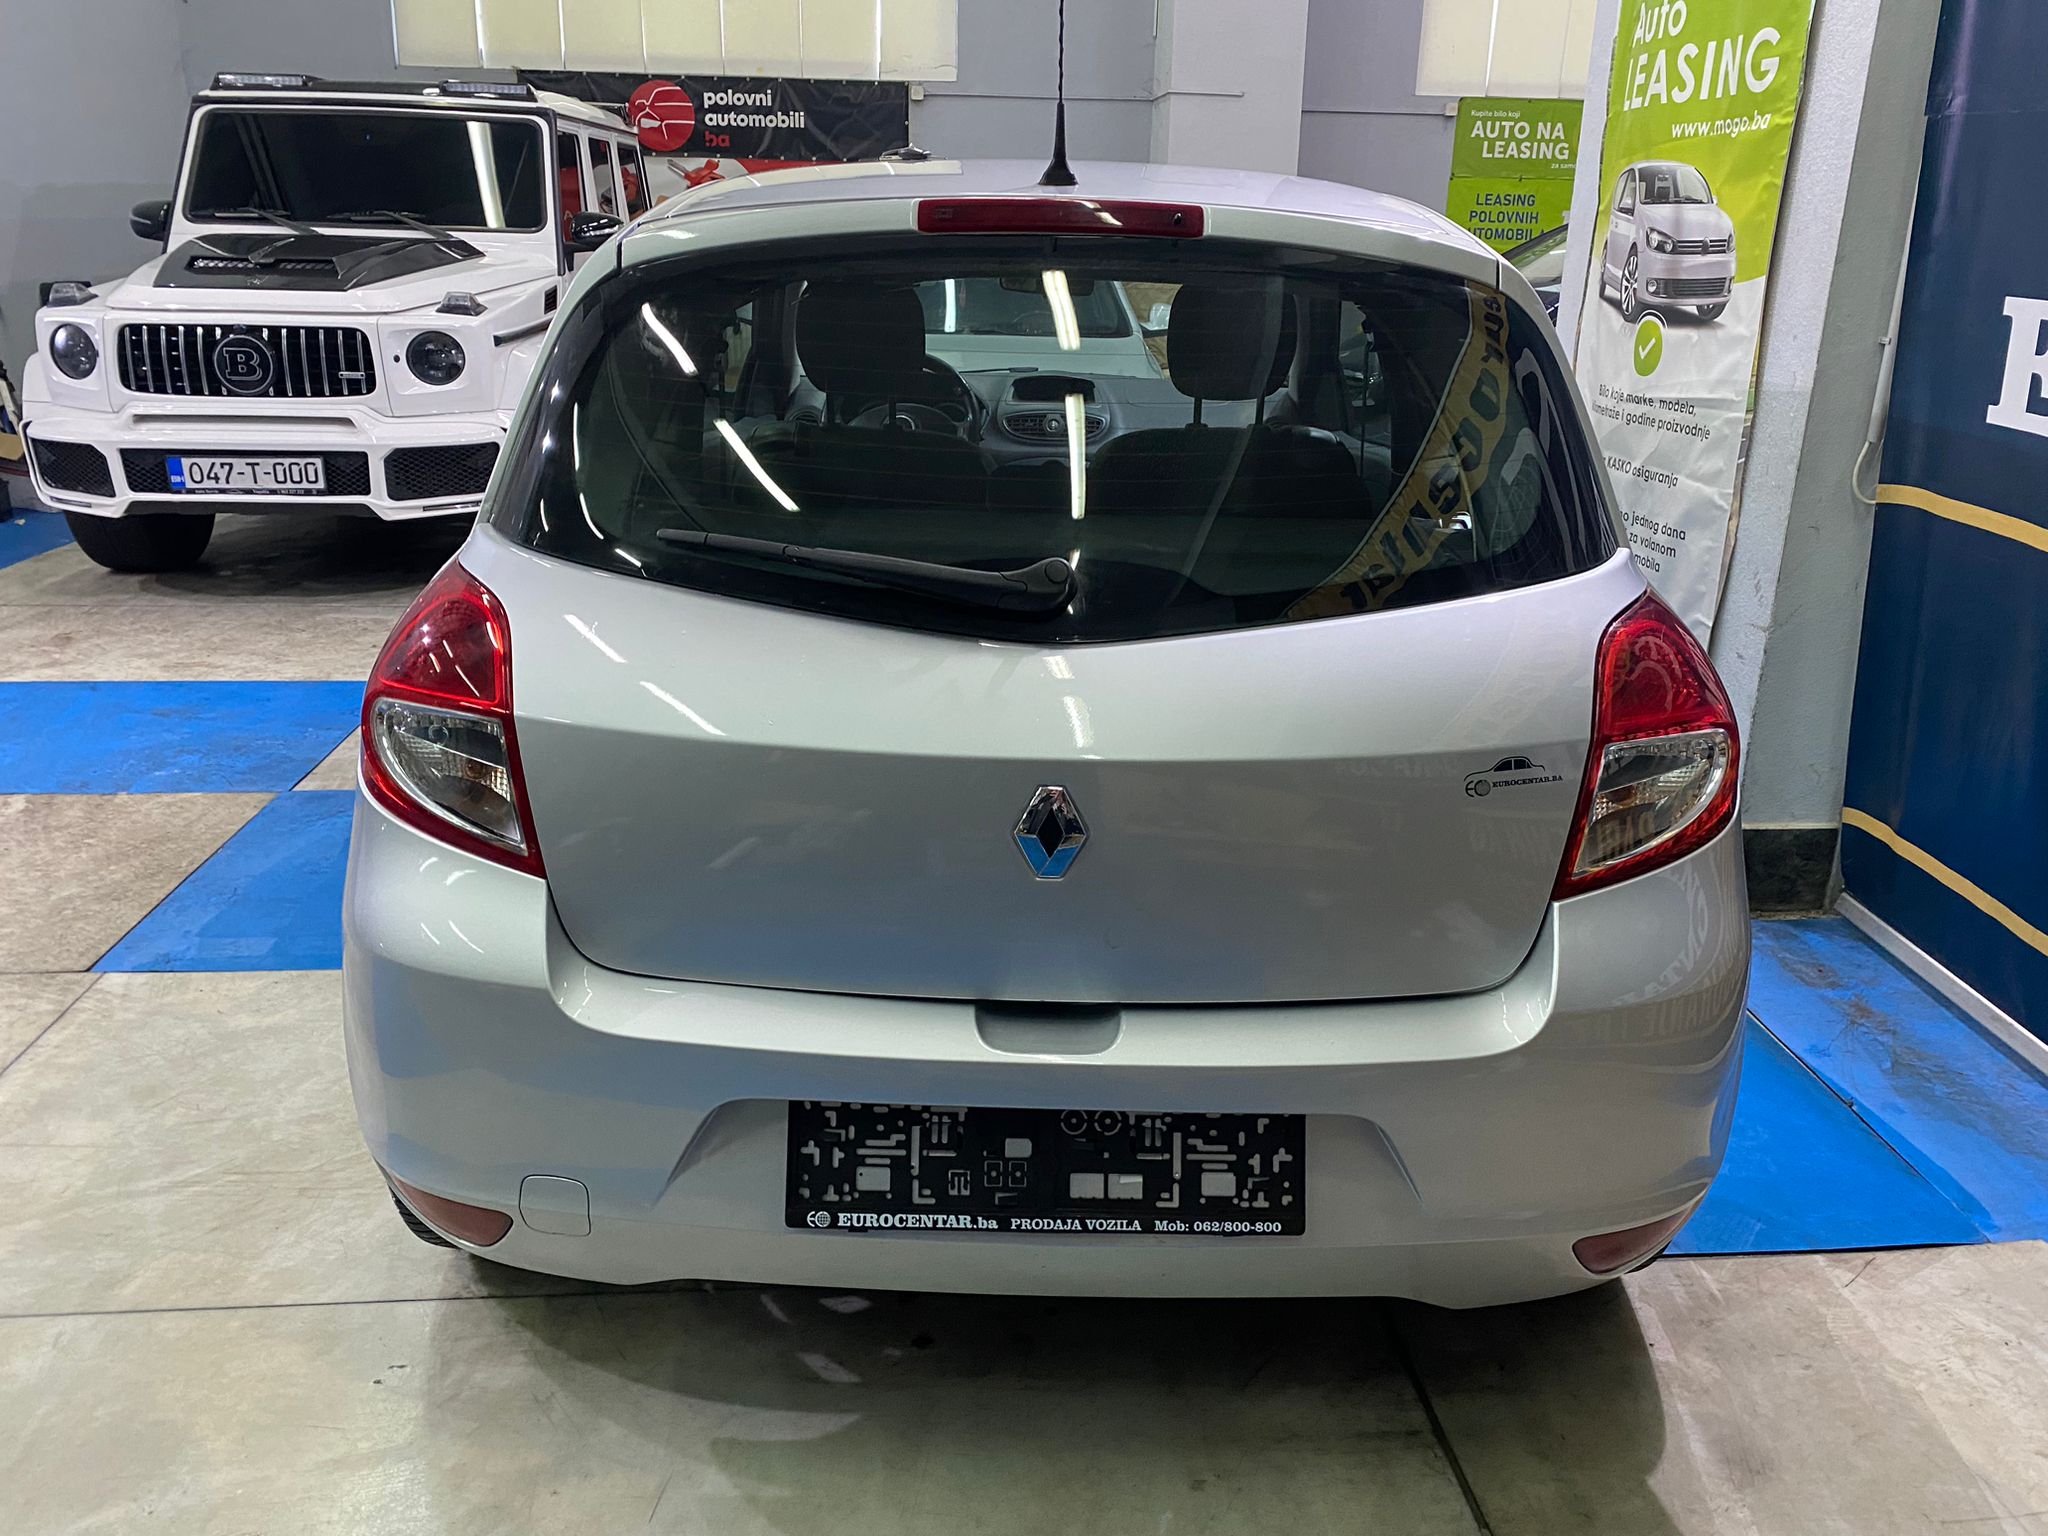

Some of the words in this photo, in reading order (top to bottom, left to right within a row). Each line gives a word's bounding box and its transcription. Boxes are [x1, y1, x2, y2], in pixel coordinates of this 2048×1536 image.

[1633, 0, 1687, 48] Auto
[1623, 27, 1781, 111] LEASING
[703, 89, 772, 108] polovni
[704, 111, 805, 128] automobili
[1471, 121, 1531, 139] AUTO
[1536, 122, 1565, 139] NA
[1671, 109, 1772, 138] www.mogo.ba
[1482, 141, 1569, 159] LEASING
[1476, 193, 1536, 206] LEASING
[1469, 210, 1539, 224] POLOVNIH
[223, 347, 262, 380] B
[1610, 387, 1624, 404] koje
[1625, 393, 1656, 409] marke,
[1658, 399, 1697, 417] modela,
[1625, 411, 1656, 428] godine
[1657, 418, 1711, 441] proizvodnje
[189, 462, 319, 485] 047-T-000
[1607, 456, 1632, 474] KASKO
[1632, 465, 1678, 488] osiguranja
[1631, 511, 1660, 535] jednog
[1661, 523, 1686, 540] dana
[1629, 532, 1638, 544] za
[1640, 537, 1676, 558] volanom
[1634, 553, 1660, 572] mobila
[1492, 775, 1563, 788] EUROCENTAR.BA
[838, 1212, 999, 1230] EUROCENTAR.ba
[1010, 1218, 1082, 1231] PRODAJA
[1086, 1219, 1142, 1231] VOZILA
[1154, 1220, 1189, 1232] Mob:
[1193, 1221, 1282, 1233] 062/800-800
